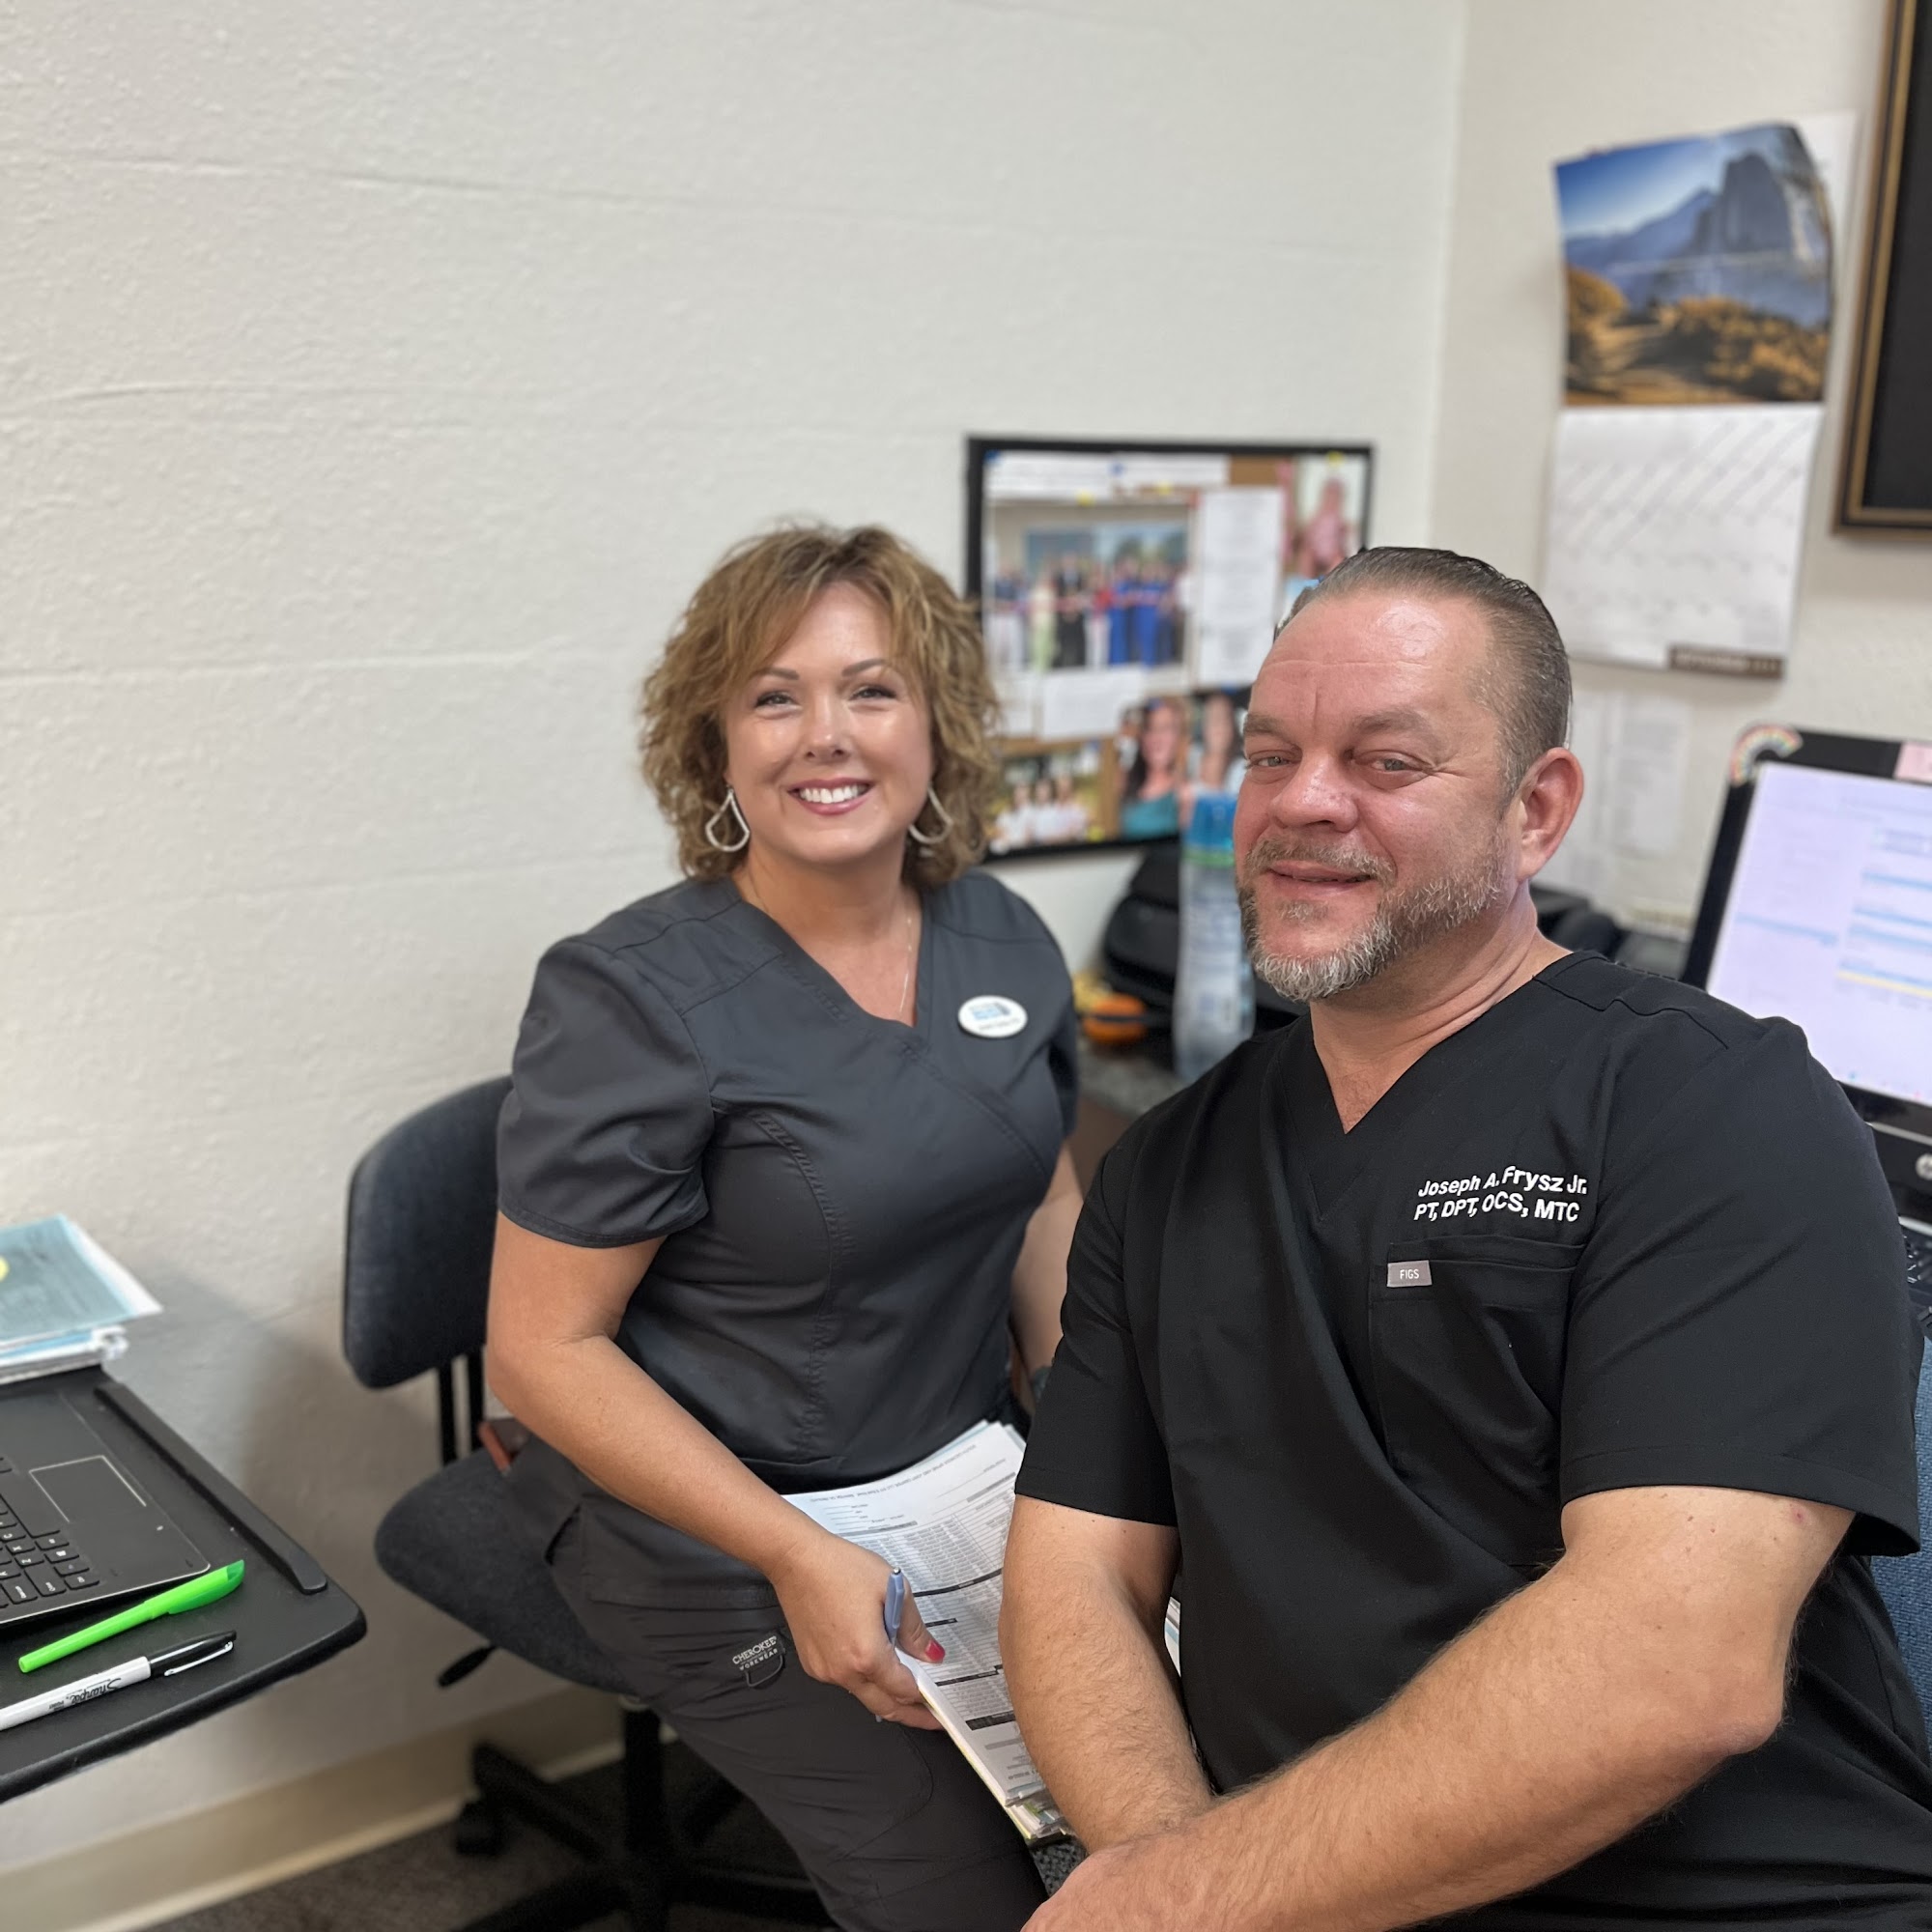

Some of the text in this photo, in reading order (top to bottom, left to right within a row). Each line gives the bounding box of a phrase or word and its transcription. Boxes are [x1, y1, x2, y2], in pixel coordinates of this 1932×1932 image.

[1418, 1175, 1481, 1197] Joseph
[1501, 1165, 1565, 1191] Frysz
[1566, 1174, 1587, 1194] Jr.
[1413, 1190, 1580, 1222] PT, DPT, OCS, MTC
[1400, 1268, 1420, 1280] FIGS
[732, 1635, 778, 1664] CHEROKEE
[739, 1648, 779, 1671] WORKWEAR
